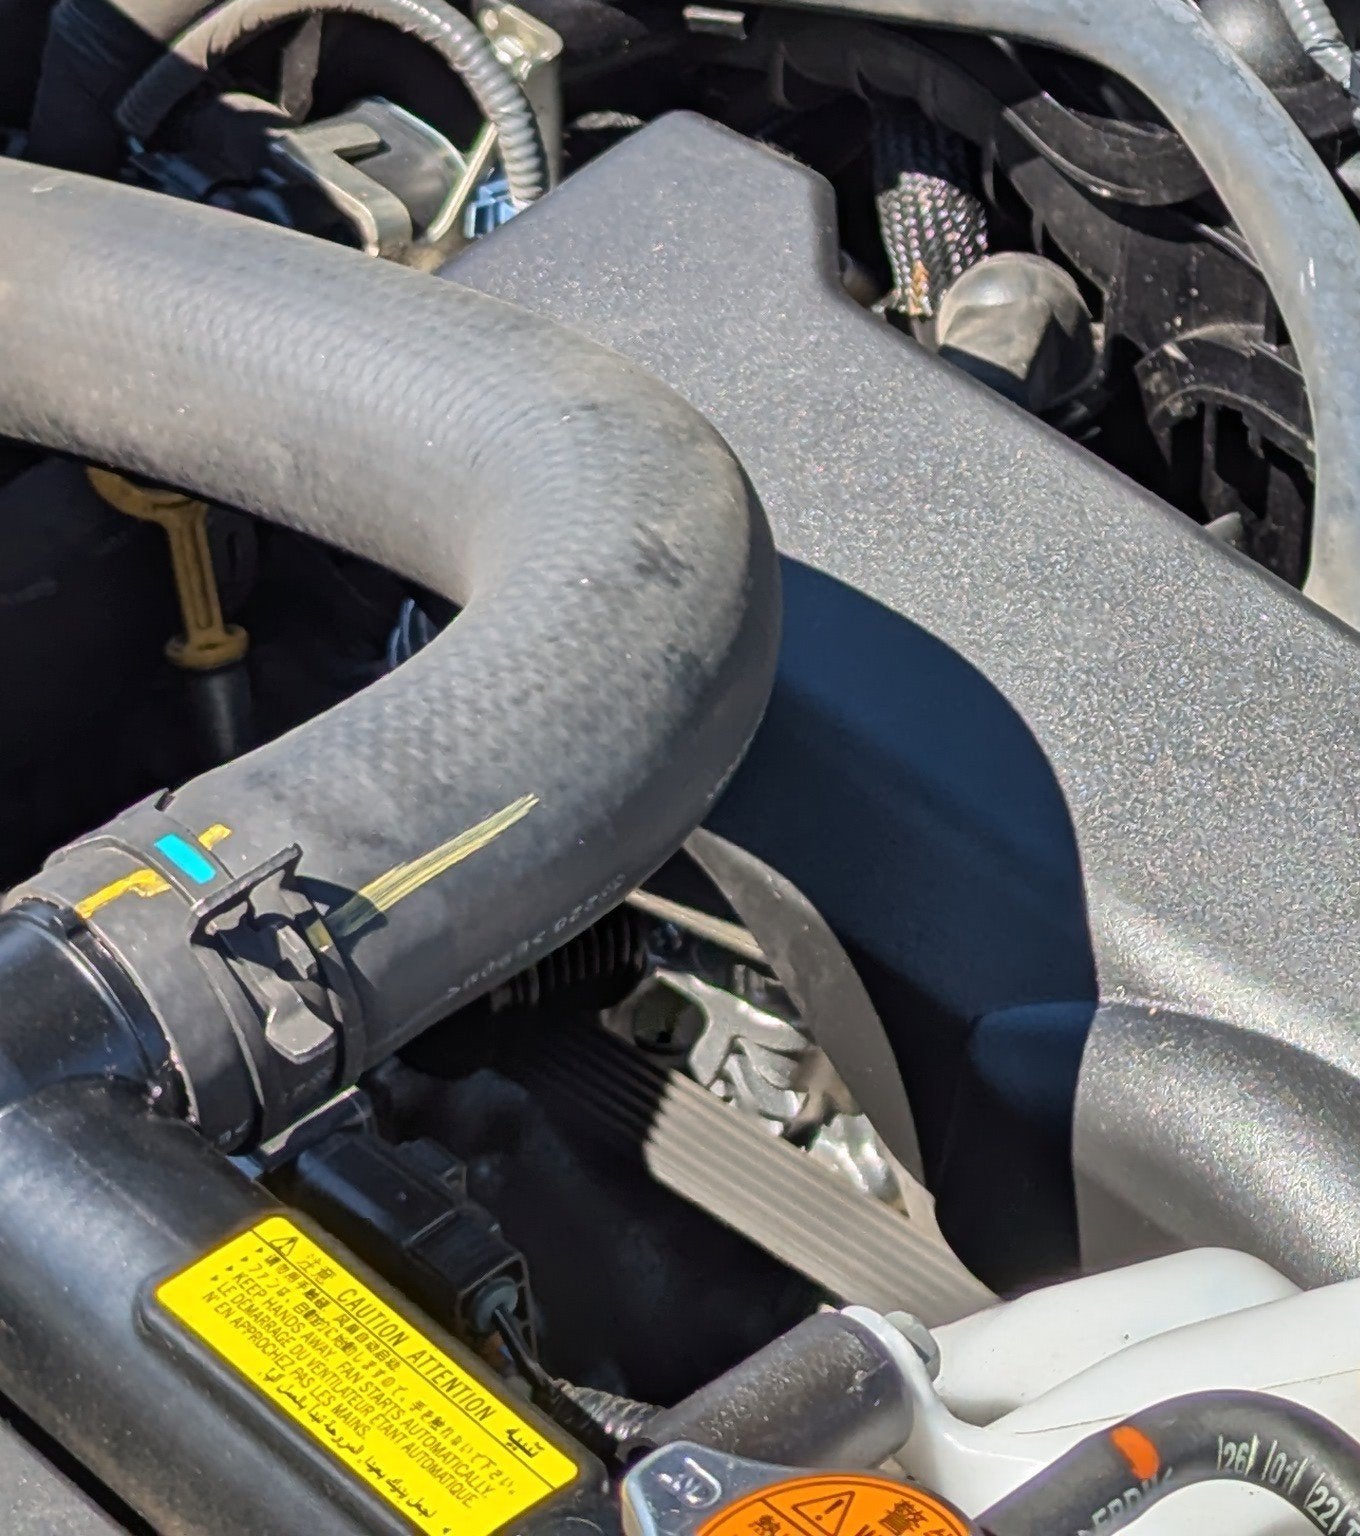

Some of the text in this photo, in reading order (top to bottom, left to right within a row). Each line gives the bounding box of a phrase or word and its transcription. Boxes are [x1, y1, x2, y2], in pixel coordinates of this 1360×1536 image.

[217, 1281, 235, 1296] LE
[289, 1344, 310, 1360] DU
[305, 1357, 373, 1415] VENTILATEUR
[230, 1316, 294, 1370] APPROCHEZ
[289, 1367, 314, 1387] PAS
[310, 1385, 336, 1406] LES
[232, 1272, 267, 1299] KEEP
[262, 1297, 305, 1333] HANDS
[336, 1361, 363, 1383] FAN
[358, 1381, 405, 1420] STARTS
[337, 1288, 495, 1421] CAUTION ATTENTION
